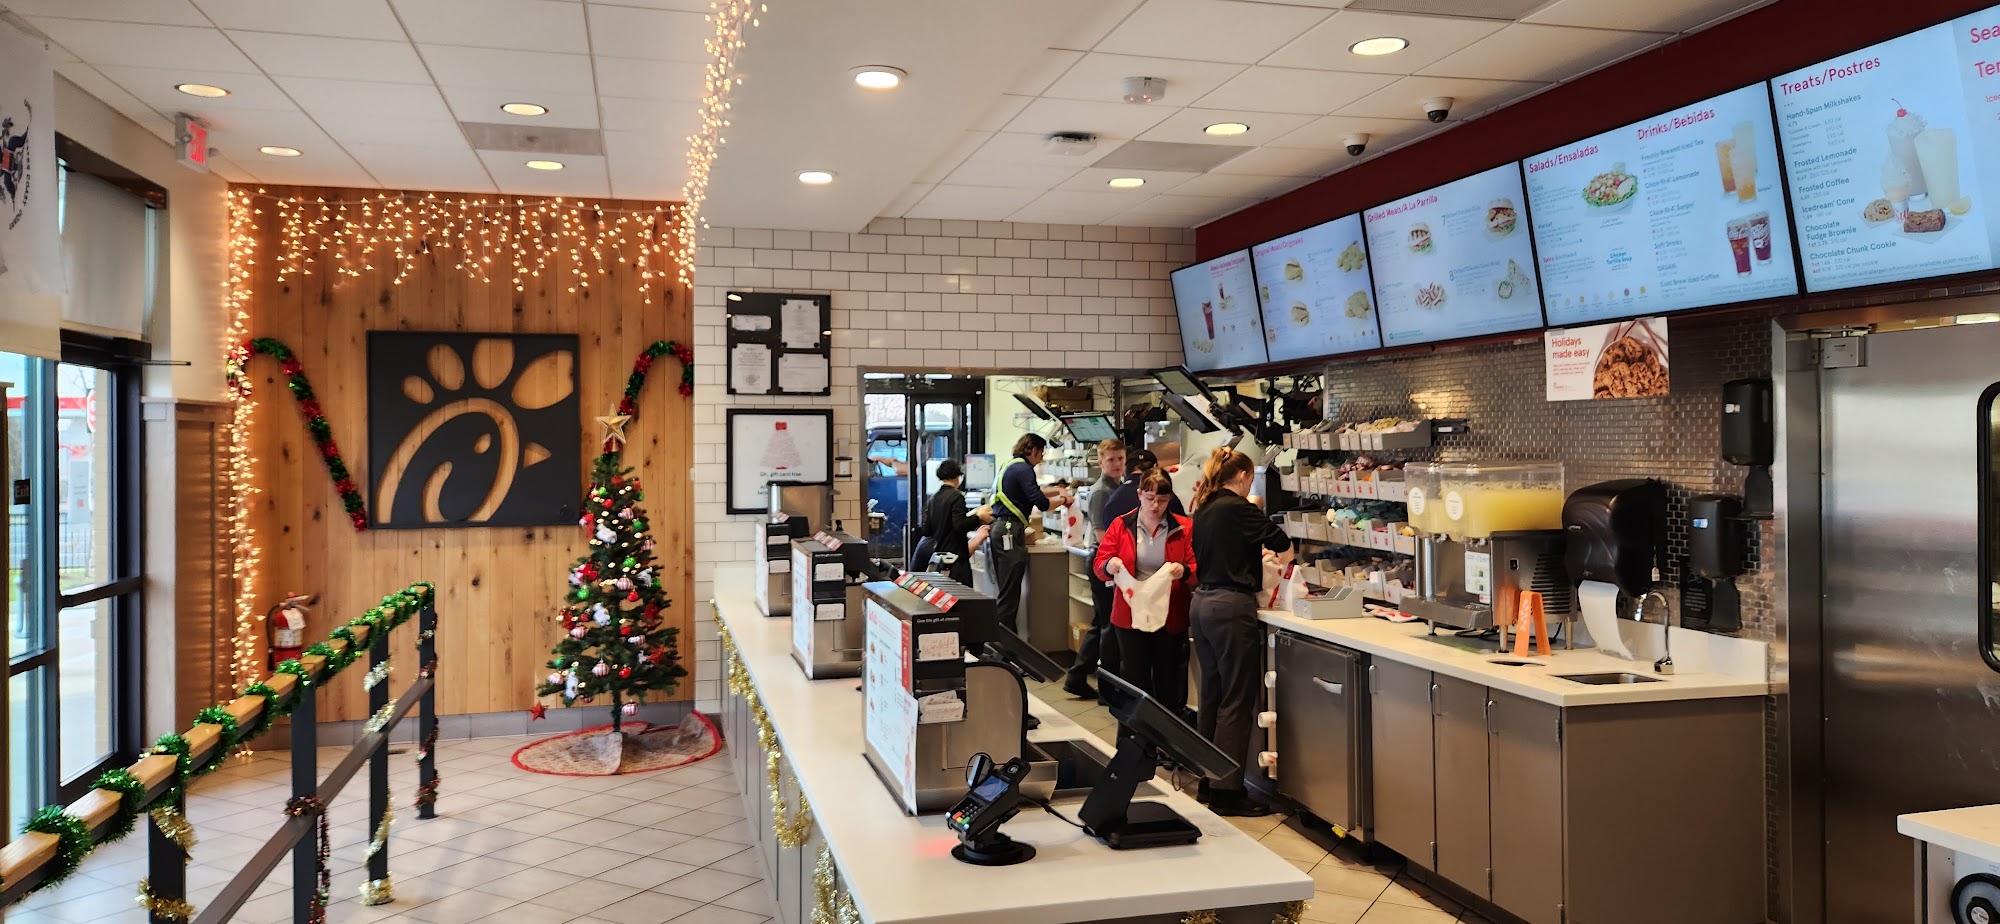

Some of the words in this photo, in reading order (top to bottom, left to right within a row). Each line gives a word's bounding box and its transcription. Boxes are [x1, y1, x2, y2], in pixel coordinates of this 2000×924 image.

[1781, 56, 1880, 96] Treats/Postres
[1786, 105, 1822, 120] Hand-Spun
[1824, 94, 1862, 110] Milkshakes
[1638, 109, 1715, 140] Drinks/Bebidas
[1529, 145, 1599, 174] Salads/Ensaladas
[1794, 156, 1820, 168] Frosted
[1820, 148, 1857, 162] Lemonade
[1798, 182, 1824, 194] Frosted
[1826, 176, 1850, 188] Coffee
[1836, 197, 1856, 206] Cone
[1368, 210, 1386, 223] Grilled
[1409, 202, 1416, 211] La
[1805, 220, 1840, 233] Chocolate
[1807, 232, 1827, 241] Fudge
[1828, 226, 1857, 238] Brownie
[1810, 248, 1845, 260] Chocolate
[1846, 244, 1869, 255] Chunk
[1870, 240, 1896, 251] Cookie
[1449, 270, 1454, 281] 8
[1552, 336, 1582, 348] Holidays
[1552, 350, 1572, 359] made
[1574, 348, 1590, 358] easy
